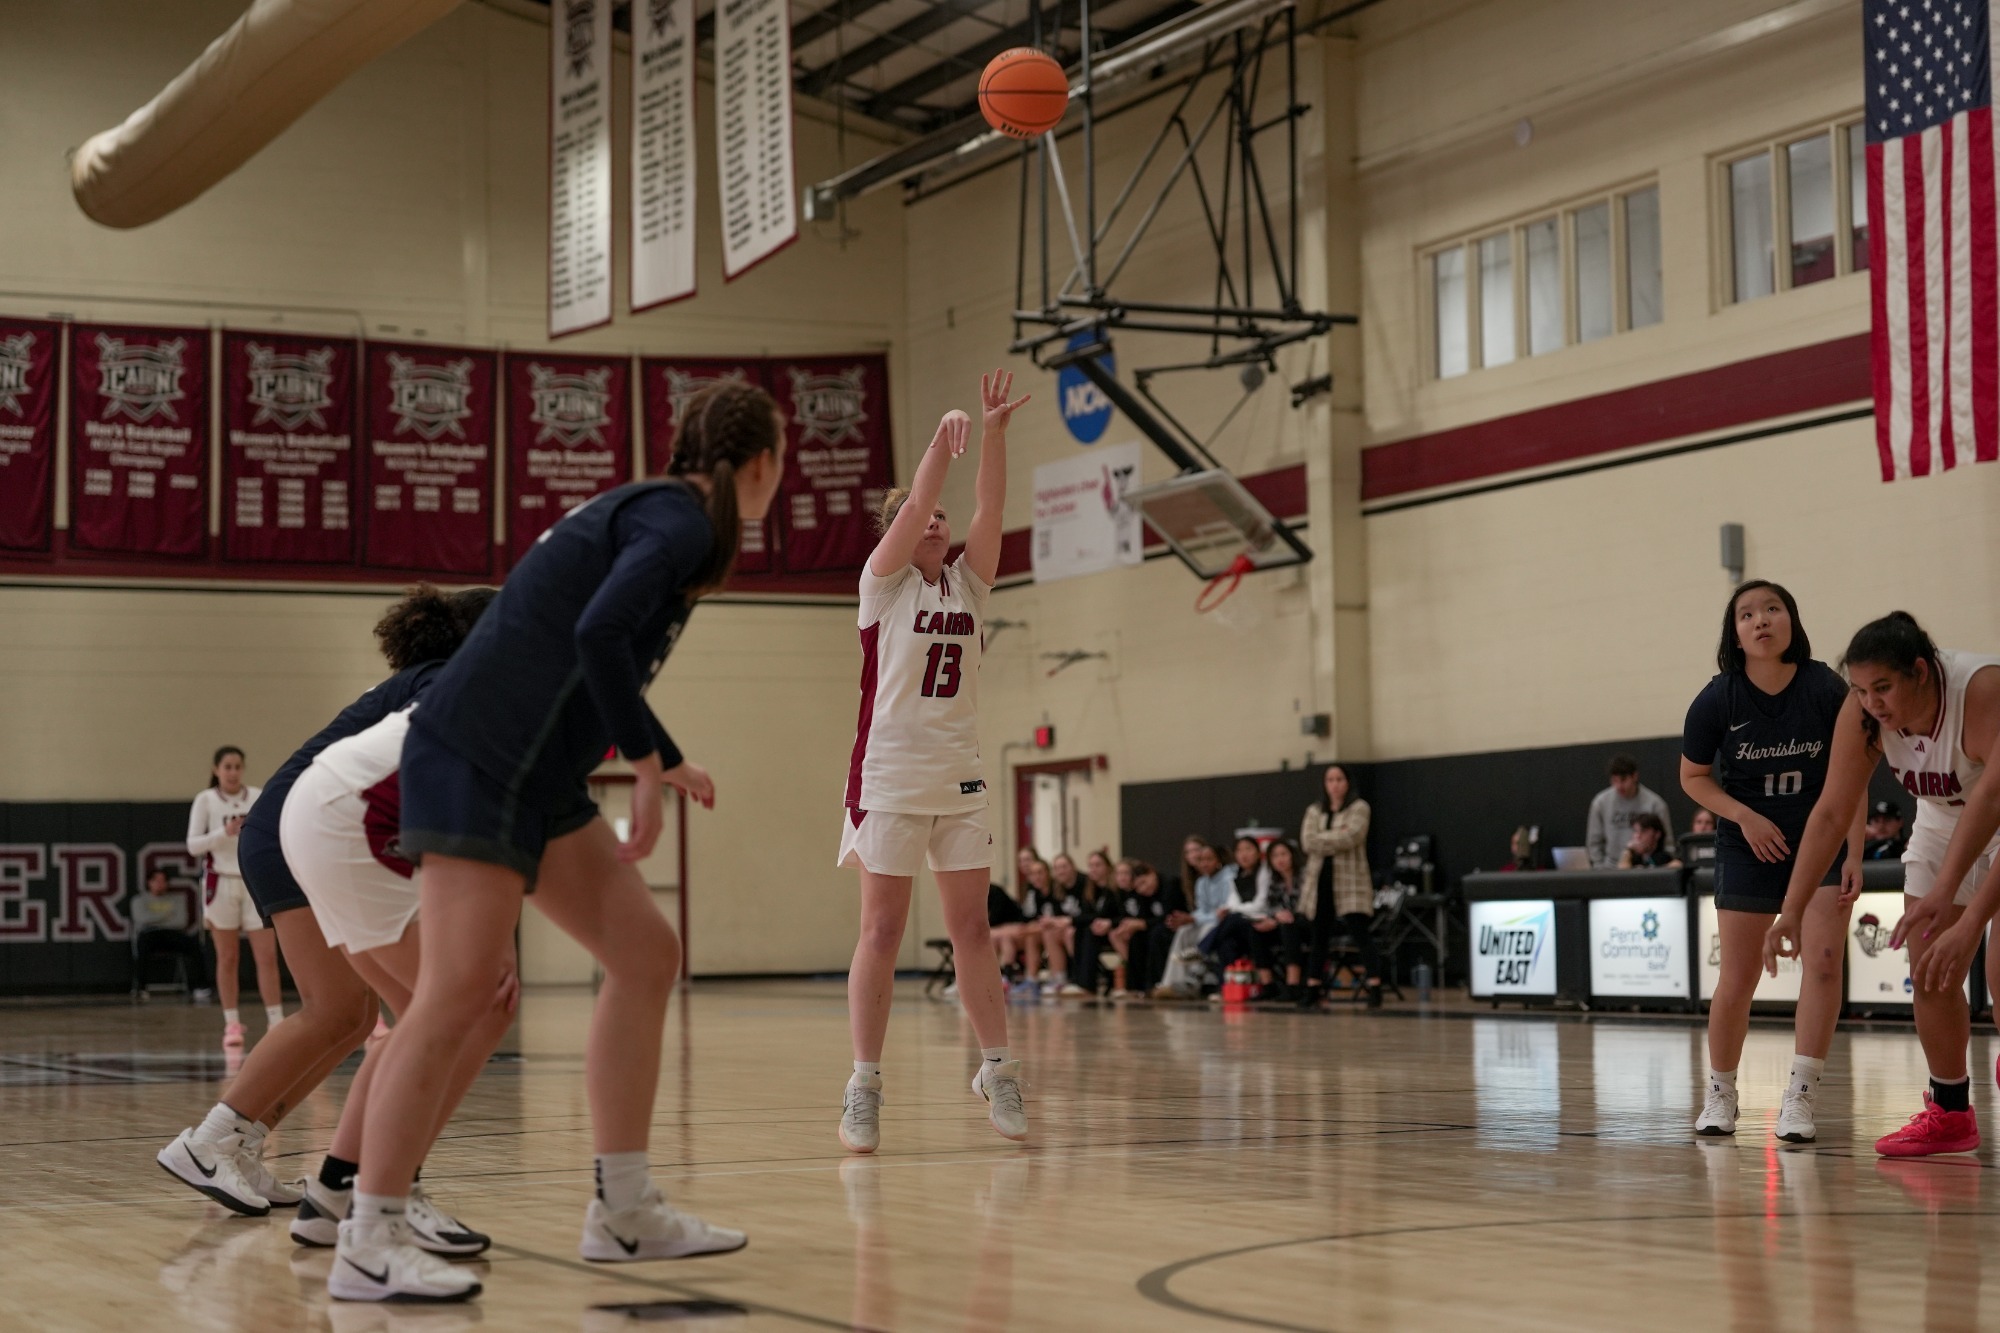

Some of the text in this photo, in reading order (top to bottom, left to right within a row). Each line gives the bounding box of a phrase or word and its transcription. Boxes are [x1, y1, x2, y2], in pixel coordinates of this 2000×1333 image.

[111, 366, 171, 394] CAIRN
[261, 374, 320, 402] CAIRN
[402, 385, 459, 410] CAIRN
[543, 392, 601, 421] CAIRN
[126, 424, 192, 443] Basketball
[287, 433, 351, 450] Basketball
[913, 610, 975, 635] CAIRN
[921, 642, 963, 698] 13
[1735, 738, 1824, 760] Harrisburg
[1764, 771, 1803, 797] 10
[1479, 924, 1535, 956] UNITED
[1610, 926, 1641, 943] Penn
[1601, 941, 1671, 963] Community
[1496, 959, 1531, 985] EAST
